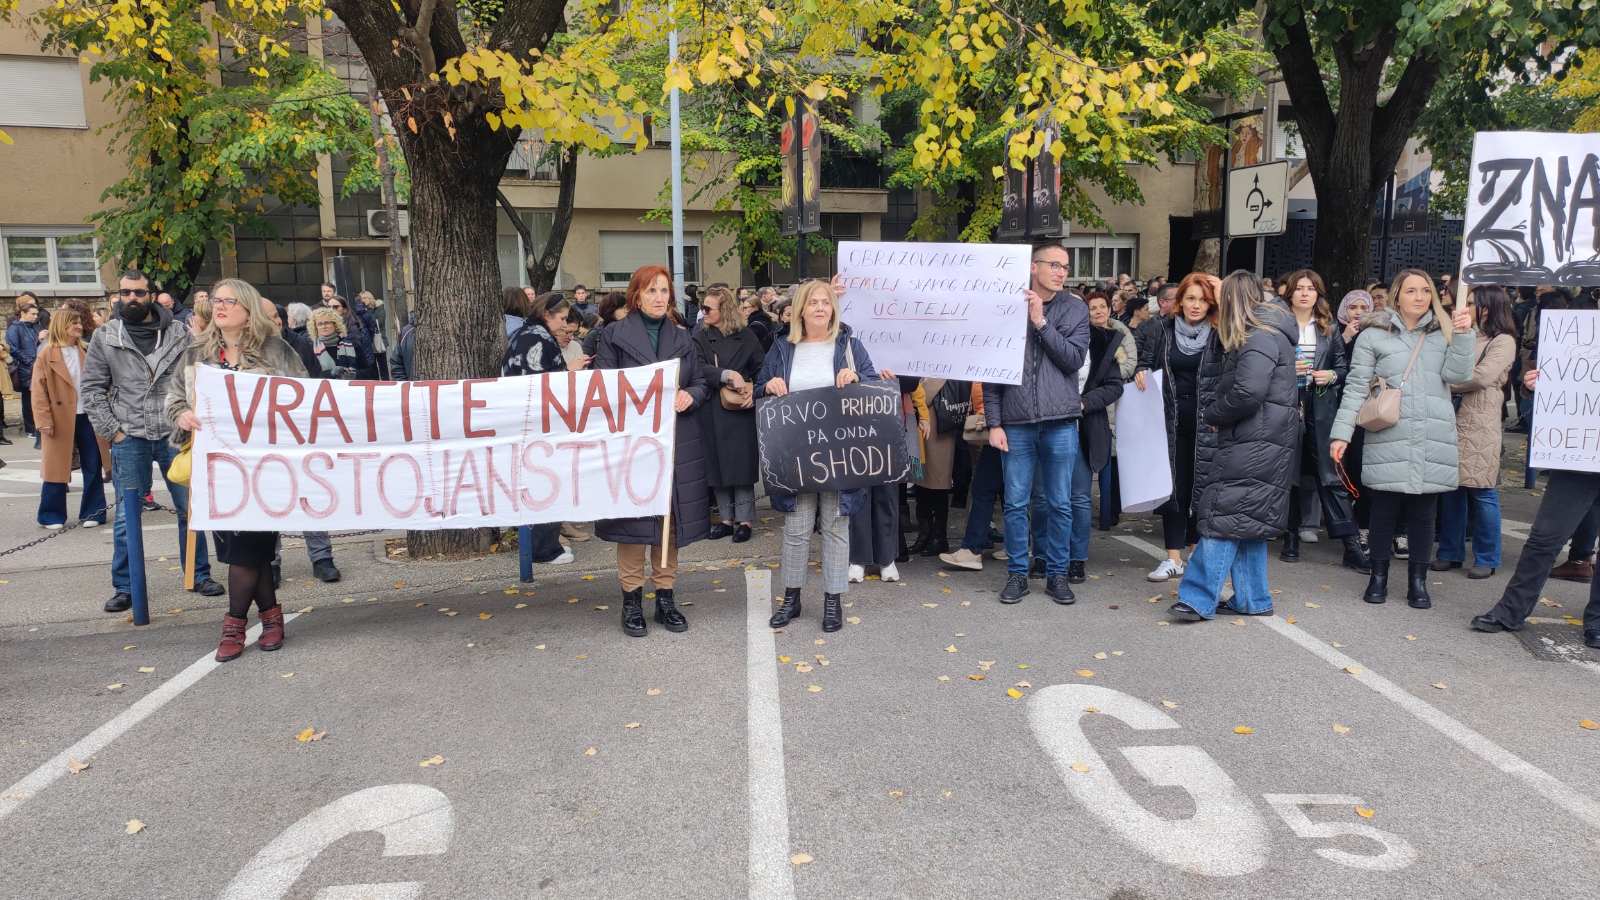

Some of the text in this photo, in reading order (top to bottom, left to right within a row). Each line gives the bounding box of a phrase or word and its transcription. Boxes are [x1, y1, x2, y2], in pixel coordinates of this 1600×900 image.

[993, 255, 1017, 270] JE
[874, 299, 970, 316] UČITELJI
[1544, 315, 1596, 346] NAJ
[224, 368, 665, 446] VRATITE NAM
[766, 395, 898, 428] PRVO PRIHODI
[807, 425, 878, 445] PA ONDA
[206, 435, 666, 520] DOSTOJANSTVO
[1028, 683, 1418, 876] G 5
